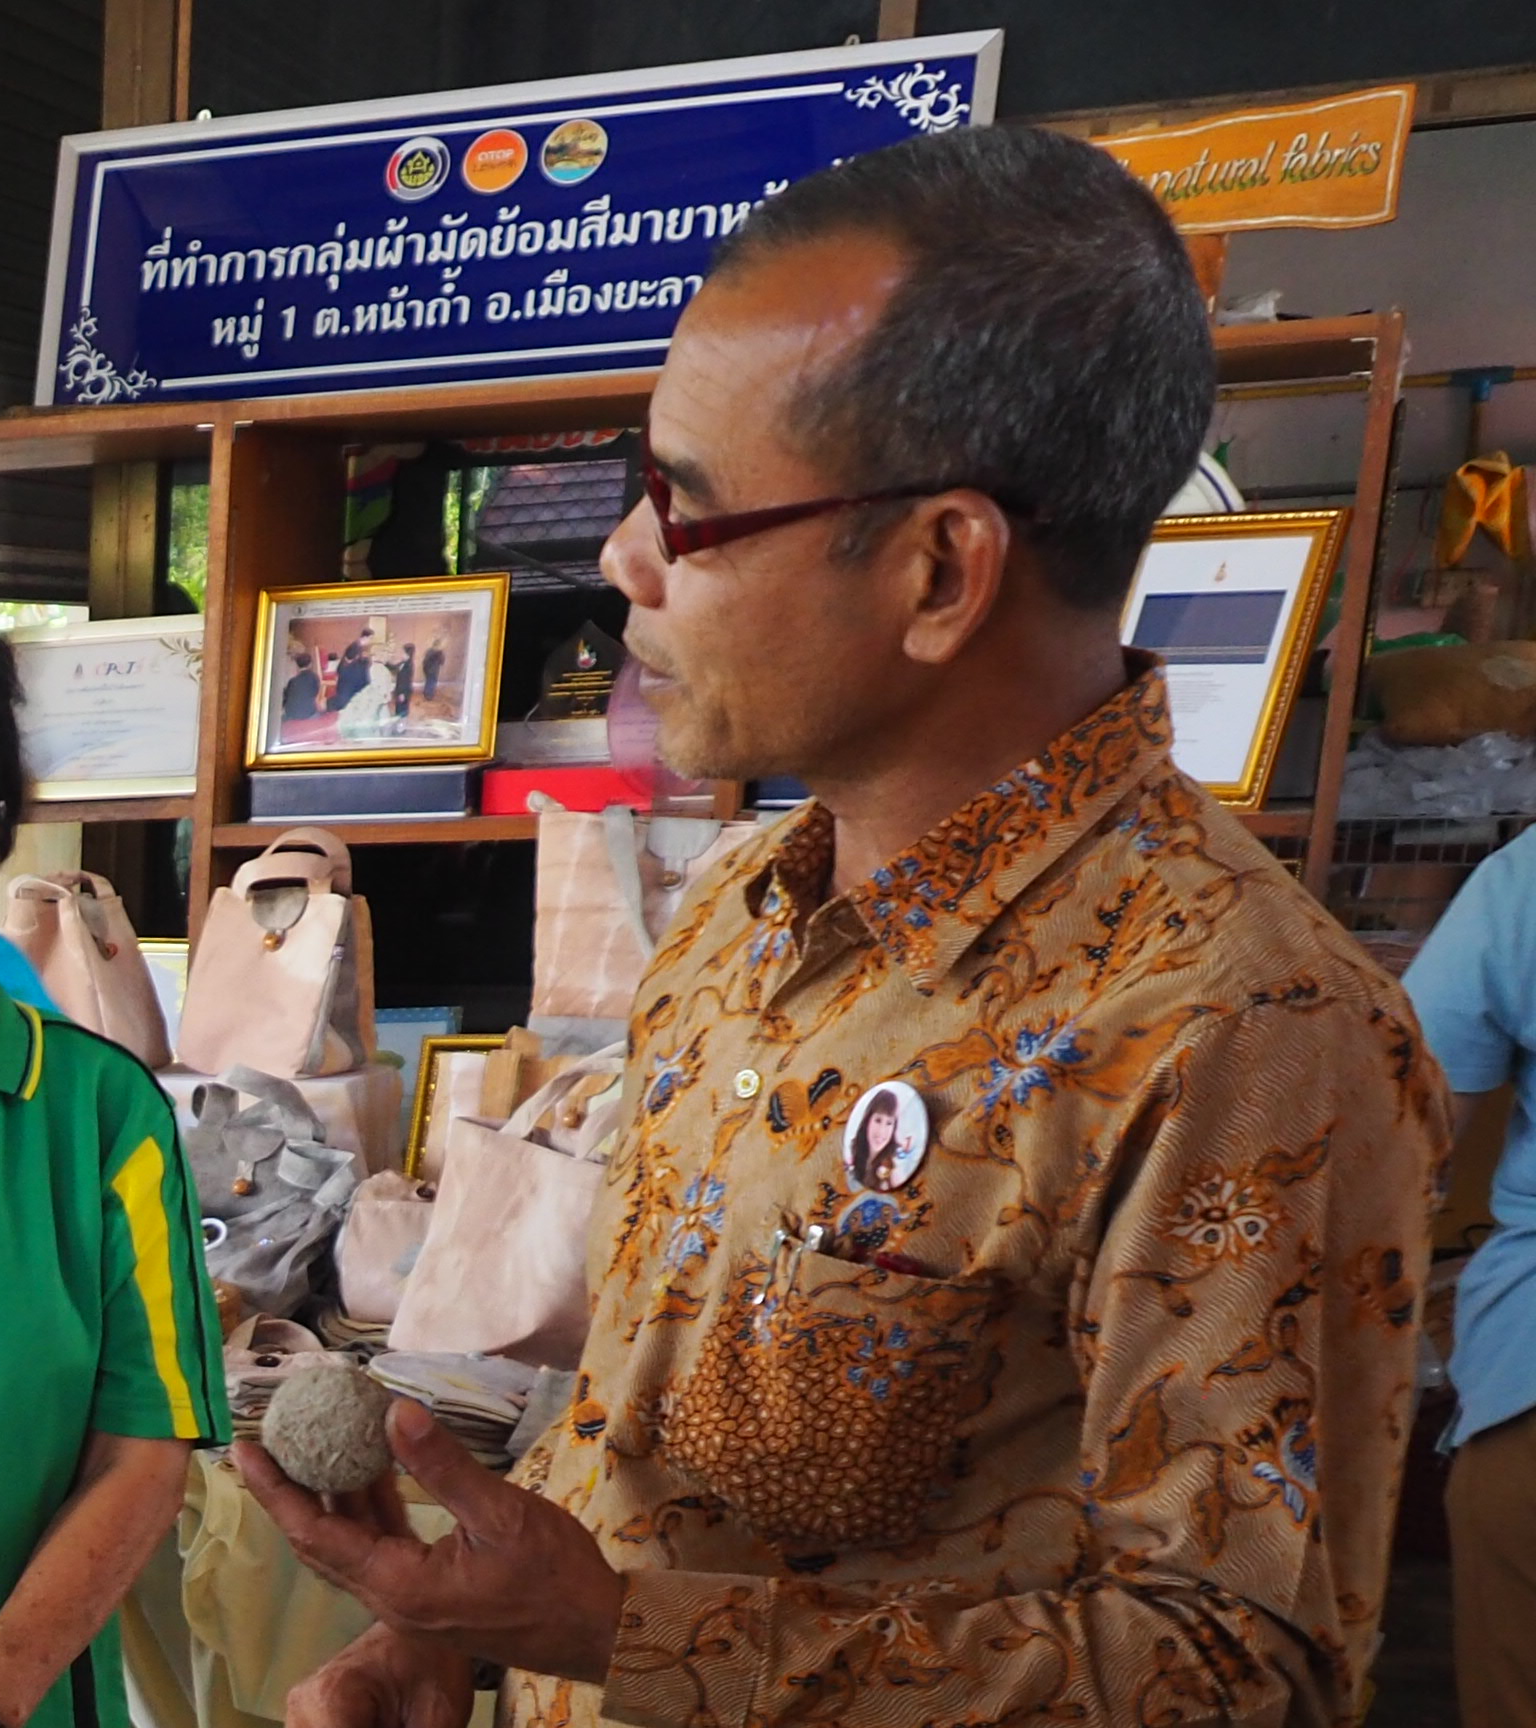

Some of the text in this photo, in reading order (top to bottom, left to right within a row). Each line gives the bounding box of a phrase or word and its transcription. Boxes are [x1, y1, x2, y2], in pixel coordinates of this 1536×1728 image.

[1148, 132, 1382, 202] natural fabrics
[211, 297, 265, 359] หมู่
[281, 306, 297, 341] 1
[313, 266, 471, 338] ต.หน้าถ้ำ
